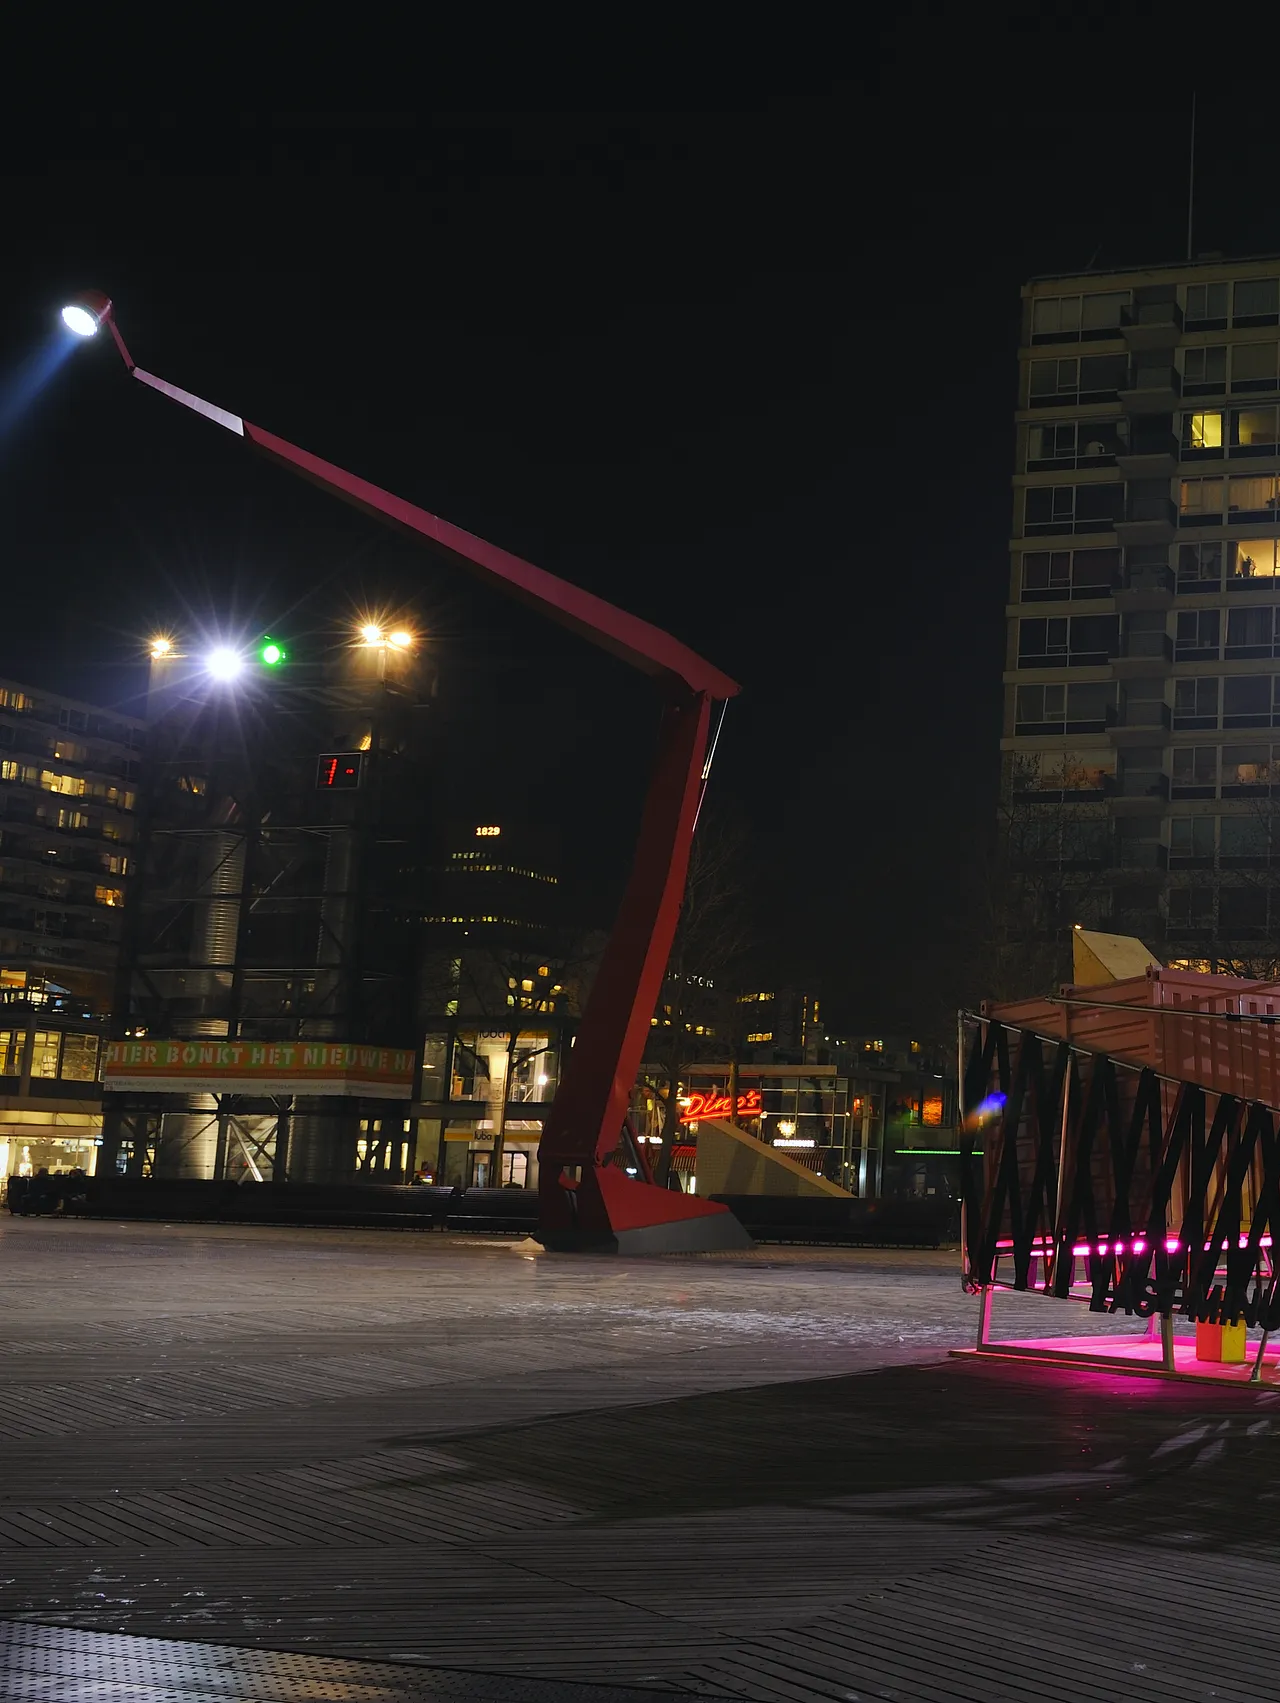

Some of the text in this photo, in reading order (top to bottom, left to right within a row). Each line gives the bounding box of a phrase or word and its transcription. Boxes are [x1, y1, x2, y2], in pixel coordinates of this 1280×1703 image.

[476, 827, 500, 835] 1829
[107, 1046, 157, 1064] HIER
[167, 1046, 243, 1064] BONKT
[252, 1048, 295, 1065] HET
[303, 1048, 389, 1068] NIEUWE
[474, 1128, 493, 1141] luba
